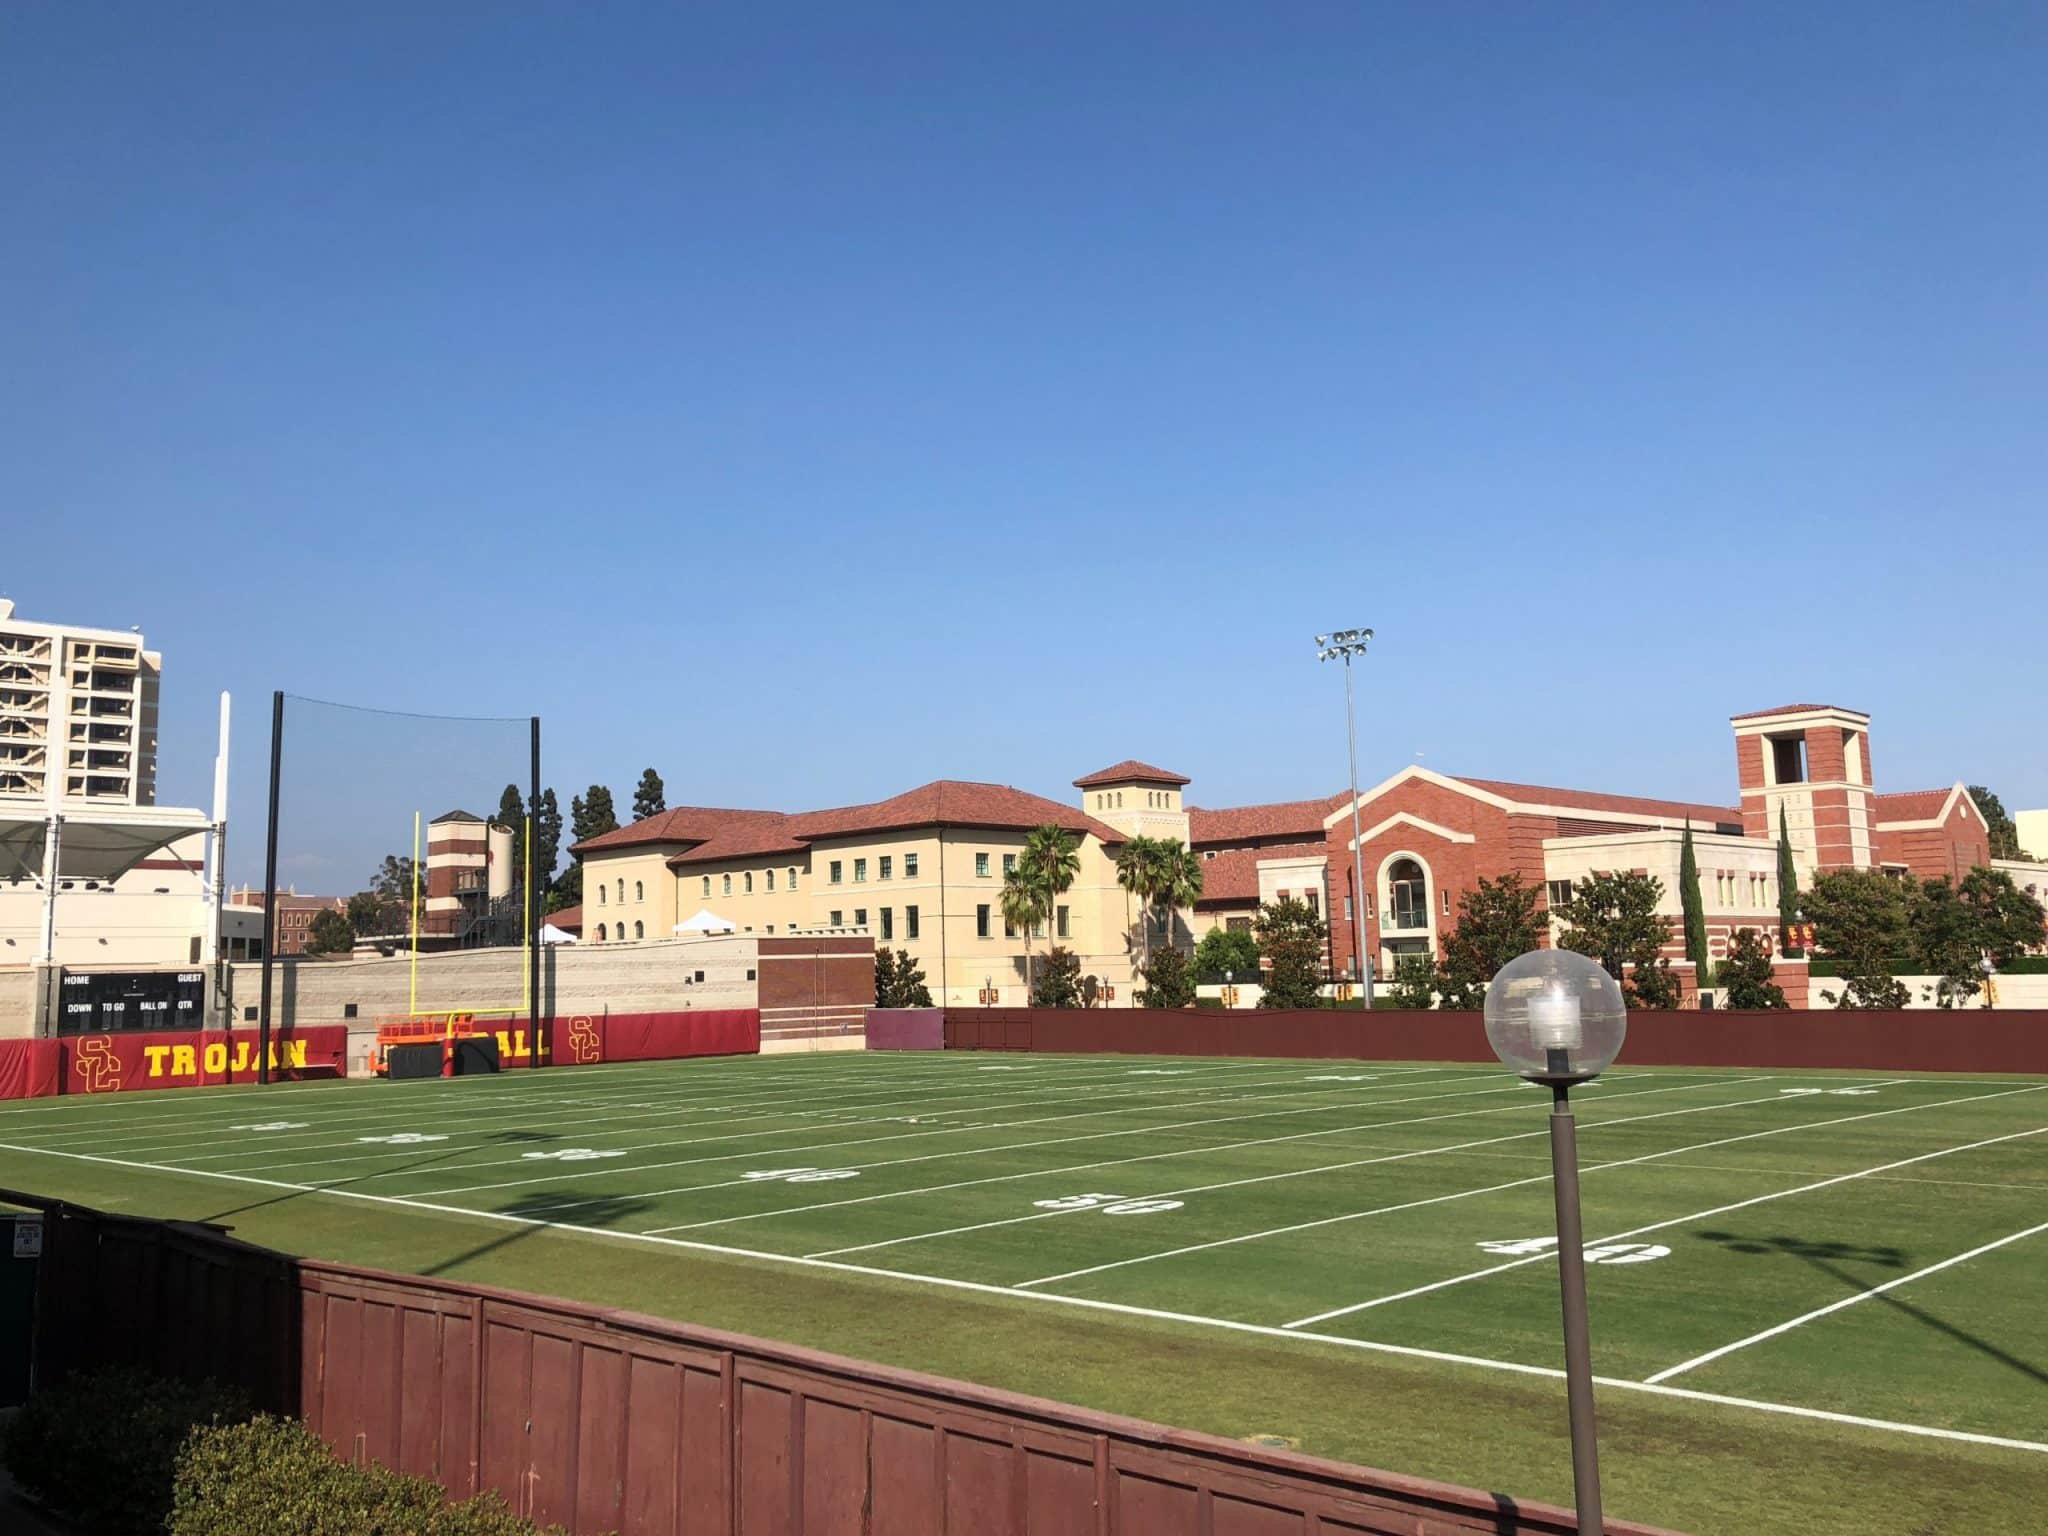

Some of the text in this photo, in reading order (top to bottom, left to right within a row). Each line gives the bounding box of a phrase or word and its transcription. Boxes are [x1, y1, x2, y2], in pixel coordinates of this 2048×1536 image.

[64, 976, 90, 985] HOME
[177, 973, 202, 983] GUEST
[67, 1003, 92, 1013] DOWN
[102, 1002, 125, 1012] TO GO
[140, 1001, 168, 1011] BALL ON
[144, 1039, 307, 1077] TROJAN
